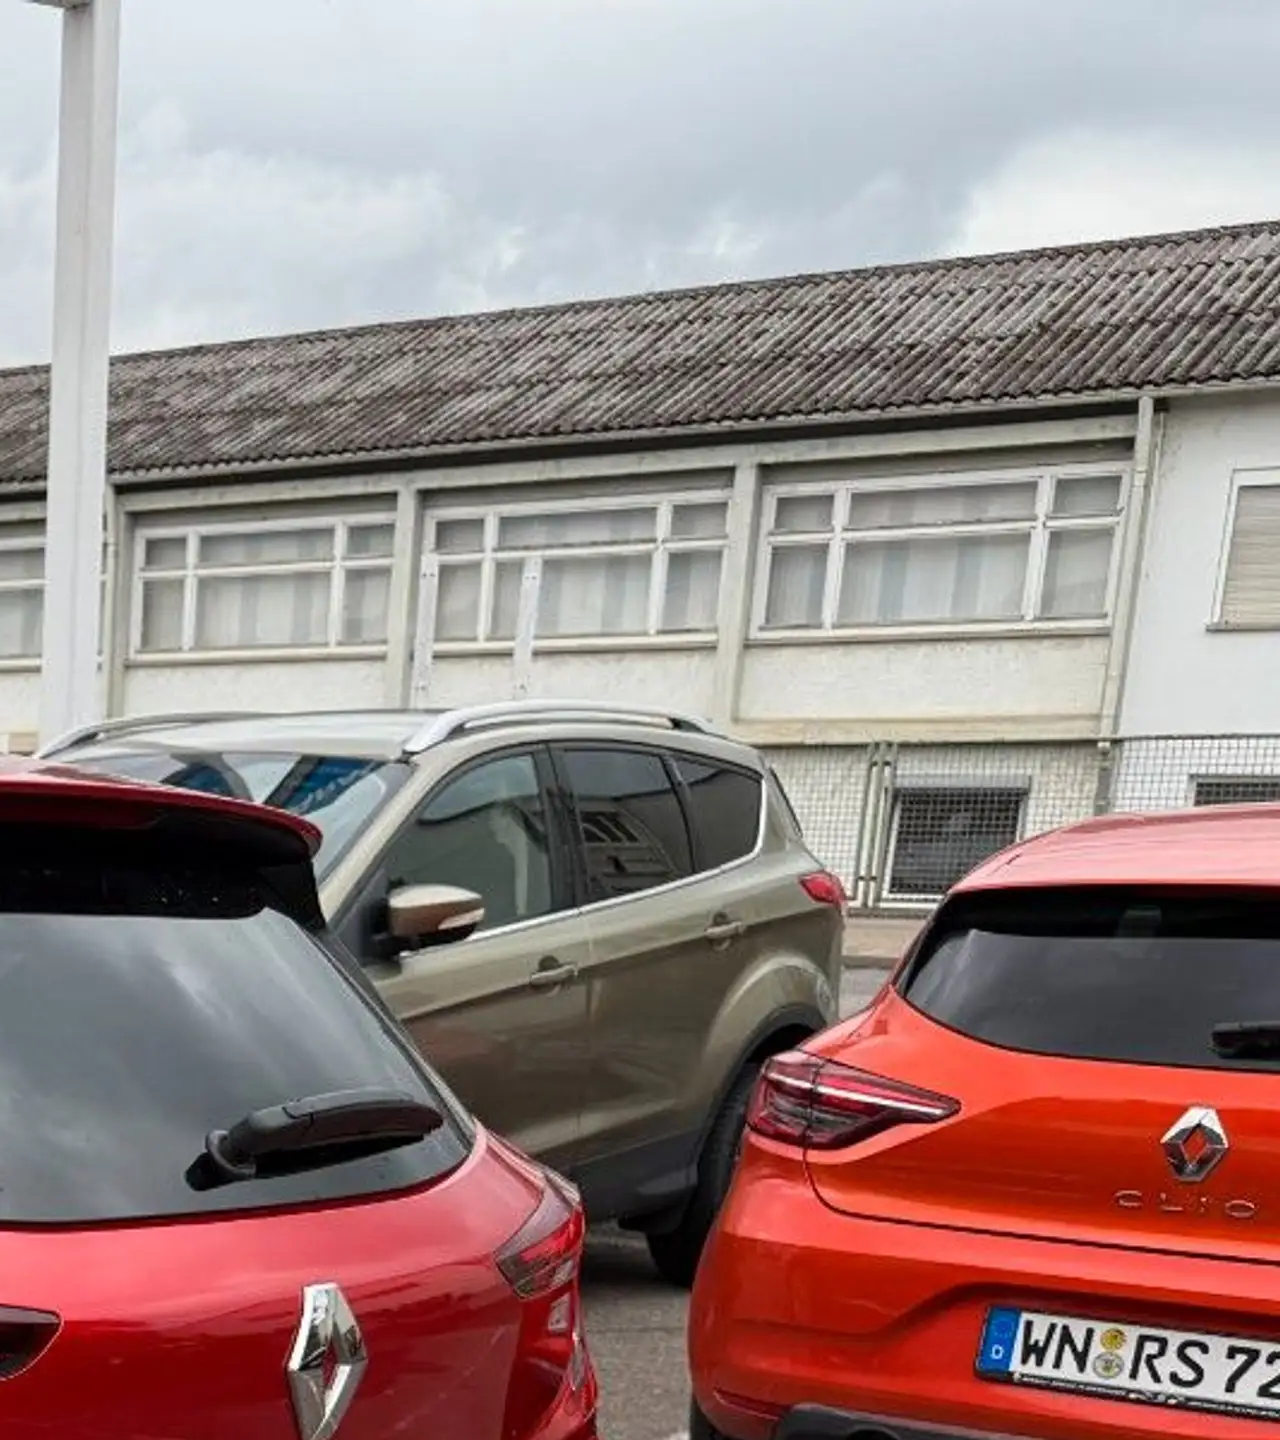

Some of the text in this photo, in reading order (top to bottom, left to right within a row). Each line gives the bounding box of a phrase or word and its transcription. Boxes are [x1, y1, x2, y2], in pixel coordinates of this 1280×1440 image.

[1114, 1189, 1257, 1219] CLIO
[1020, 1319, 1095, 1374] WN
[1128, 1333, 1210, 1389] RS
